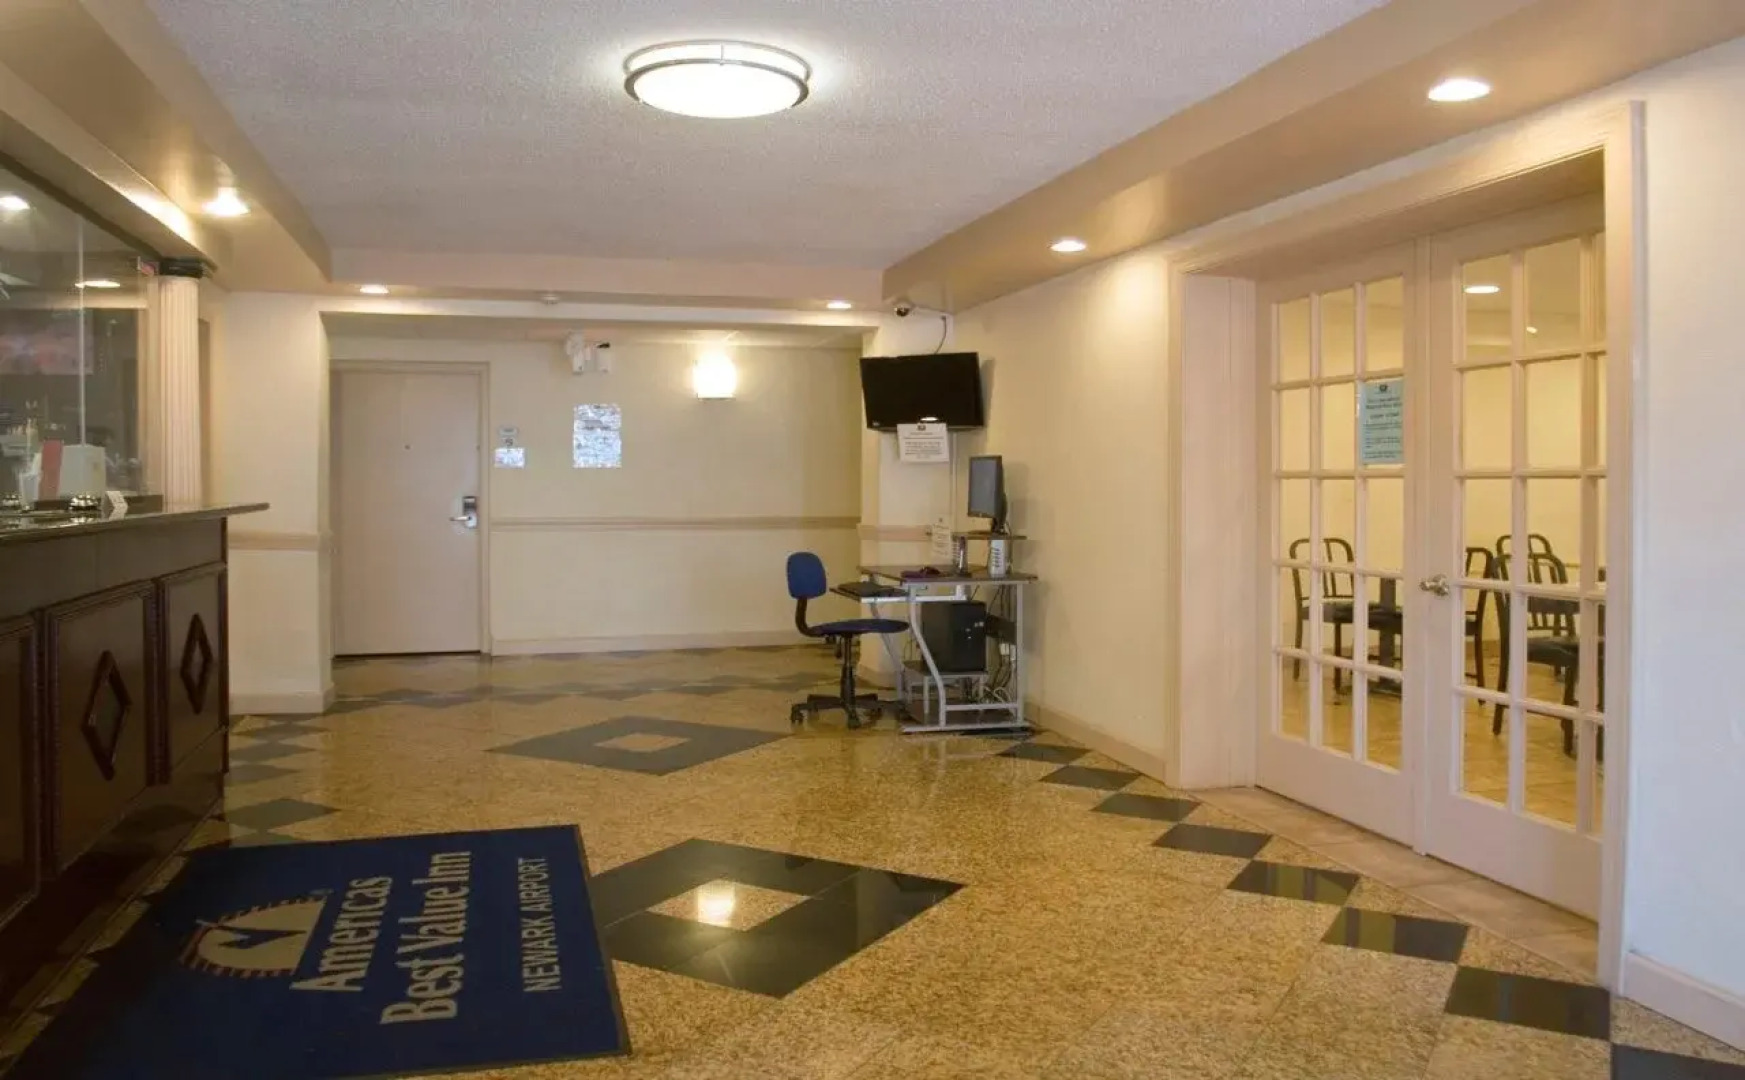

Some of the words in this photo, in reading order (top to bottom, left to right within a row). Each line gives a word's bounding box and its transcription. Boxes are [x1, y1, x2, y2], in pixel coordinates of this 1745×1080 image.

[412, 850, 473, 887] Inn
[517, 857, 555, 913] AIRPORT
[290, 875, 393, 992] Americas
[395, 887, 471, 955] Value
[520, 915, 562, 993] NEWARK
[380, 953, 465, 1025] Best
